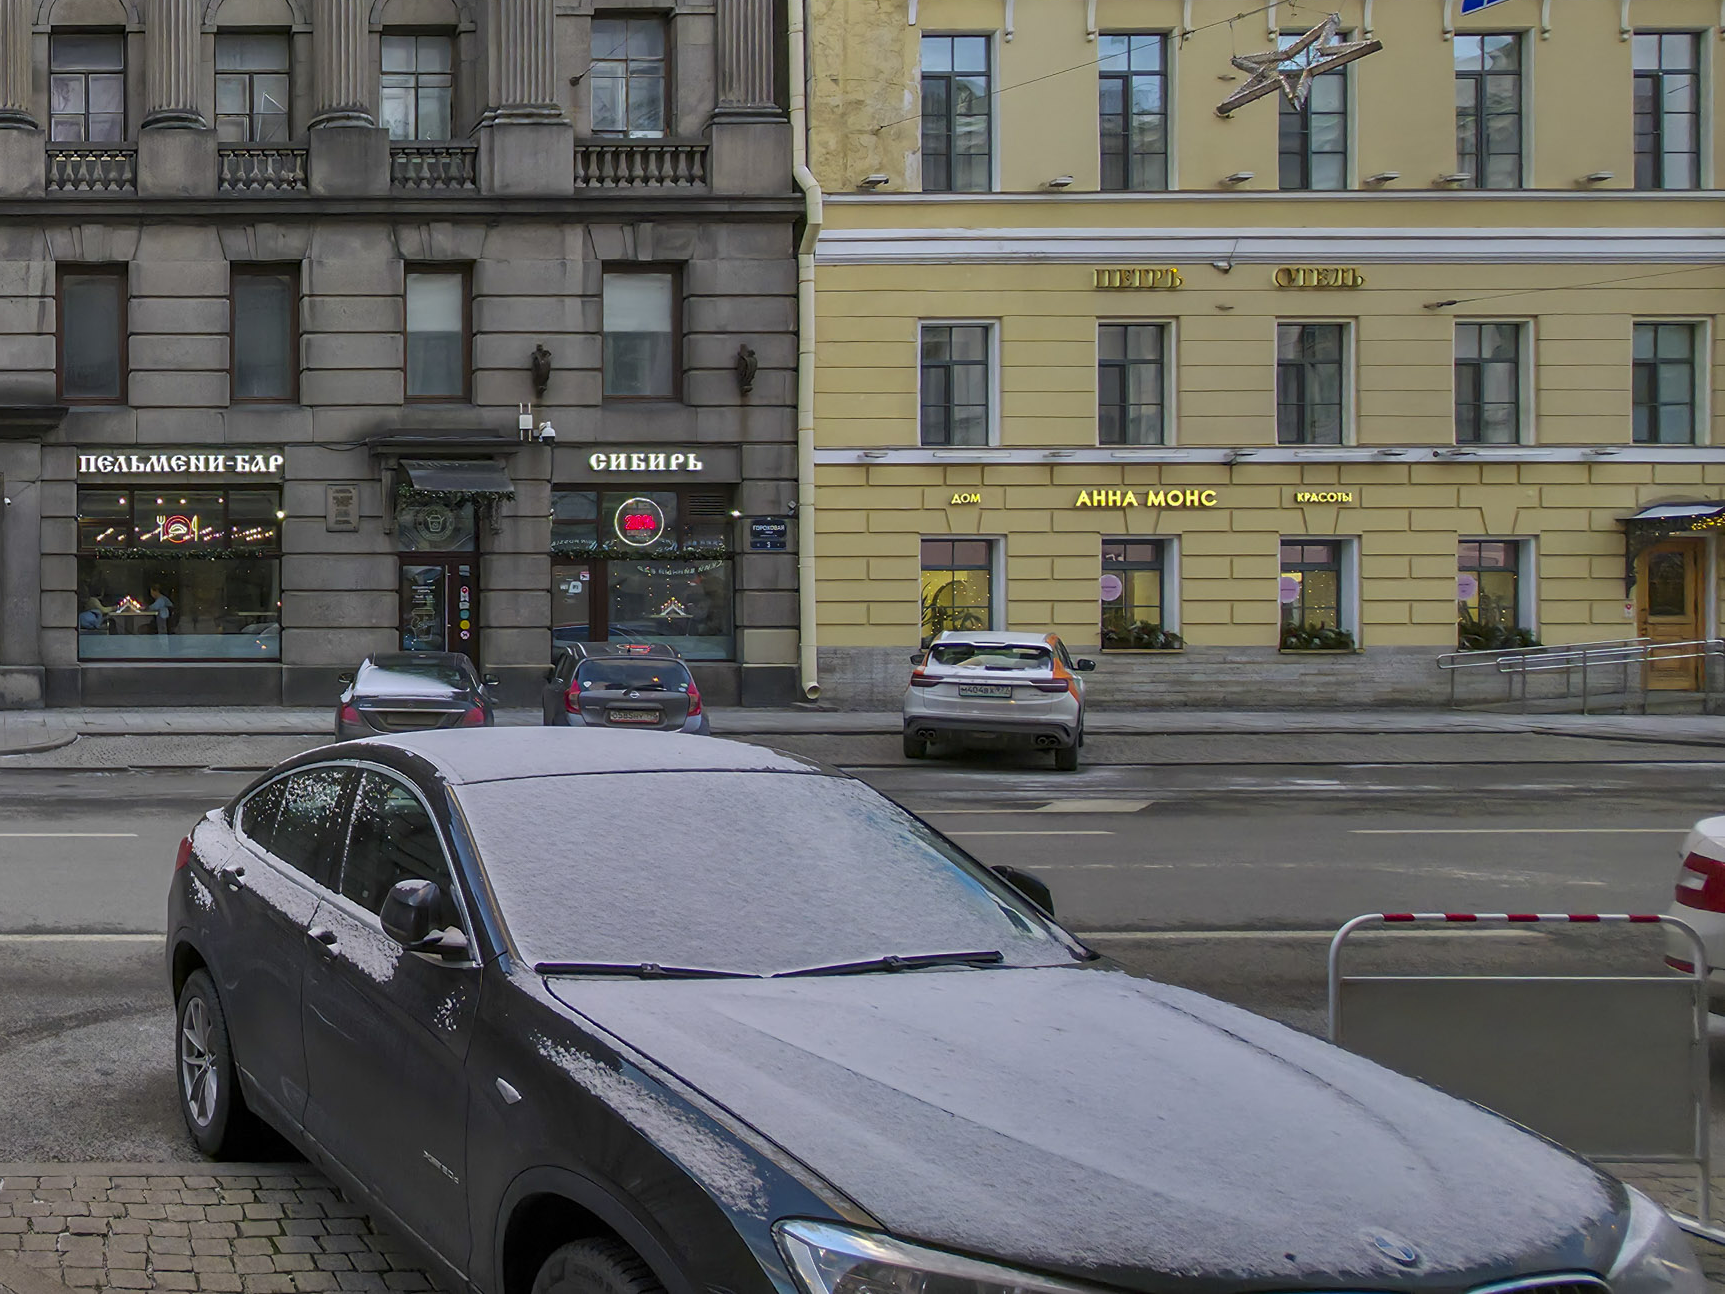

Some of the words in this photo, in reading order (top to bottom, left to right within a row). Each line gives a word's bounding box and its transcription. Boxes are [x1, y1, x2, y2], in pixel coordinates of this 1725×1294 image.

[78, 455, 284, 473] ПЕЛЬМЕНИ-БАР
[588, 453, 704, 471] СИБИРЬ
[950, 493, 981, 505] ДОМ
[1075, 489, 1139, 507] АННА
[1146, 489, 1218, 507] МОНС
[1296, 492, 1353, 503] КРАСОТЫ
